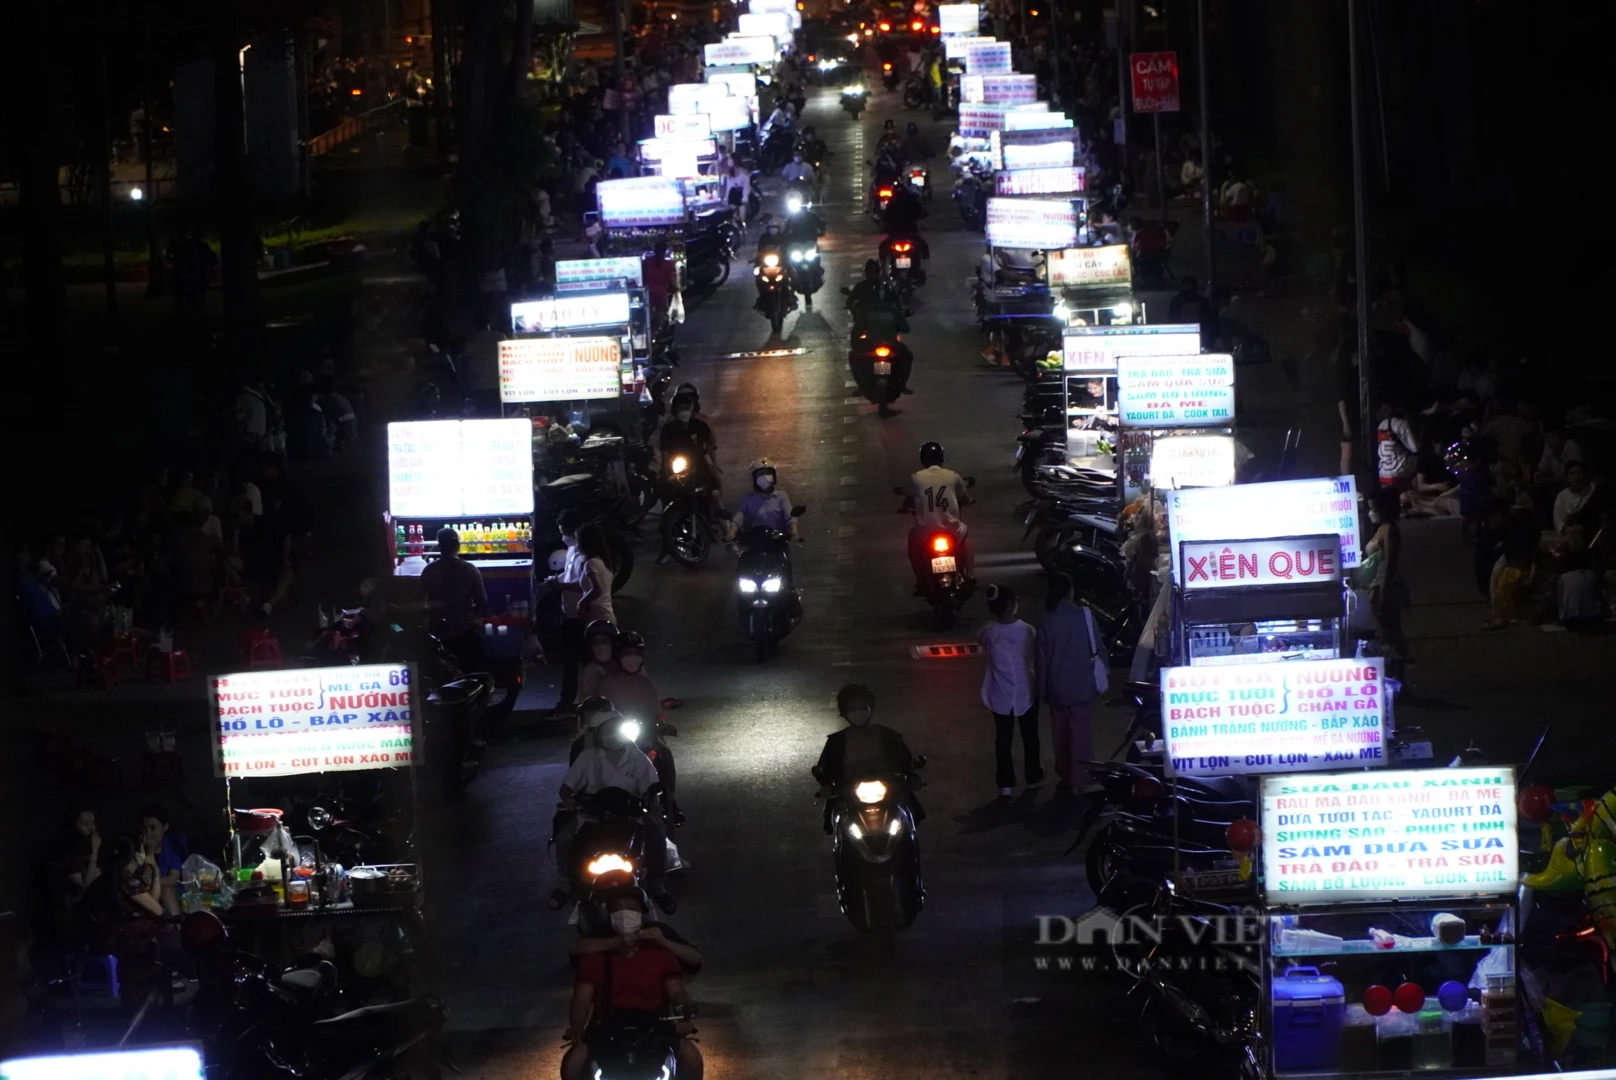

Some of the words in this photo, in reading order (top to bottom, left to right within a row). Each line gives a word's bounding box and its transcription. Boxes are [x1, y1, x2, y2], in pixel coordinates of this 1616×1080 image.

[1125, 411, 1159, 421] YAOURT
[1183, 408, 1209, 419] COOK
[1211, 407, 1230, 418] TAIL
[925, 486, 949, 512] 14
[1268, 549, 1336, 579] QUE
[389, 668, 412, 688] 68
[1226, 687, 1276, 701] TƯƠI
[1170, 706, 1221, 722] BẠCH
[1227, 701, 1277, 718] TUỘC
[1358, 746, 1383, 760] ME
[1422, 776, 1502, 788] XANH
[1276, 797, 1309, 810] RAU
[1387, 791, 1431, 804] XANH
[1476, 787, 1501, 800] ME
[1318, 811, 1355, 825] TƯƠI
[1411, 804, 1473, 819] YAOURT
[1462, 819, 1505, 834] LINH
[1423, 871, 1469, 886] COOK
[1474, 869, 1507, 884] TAIL
